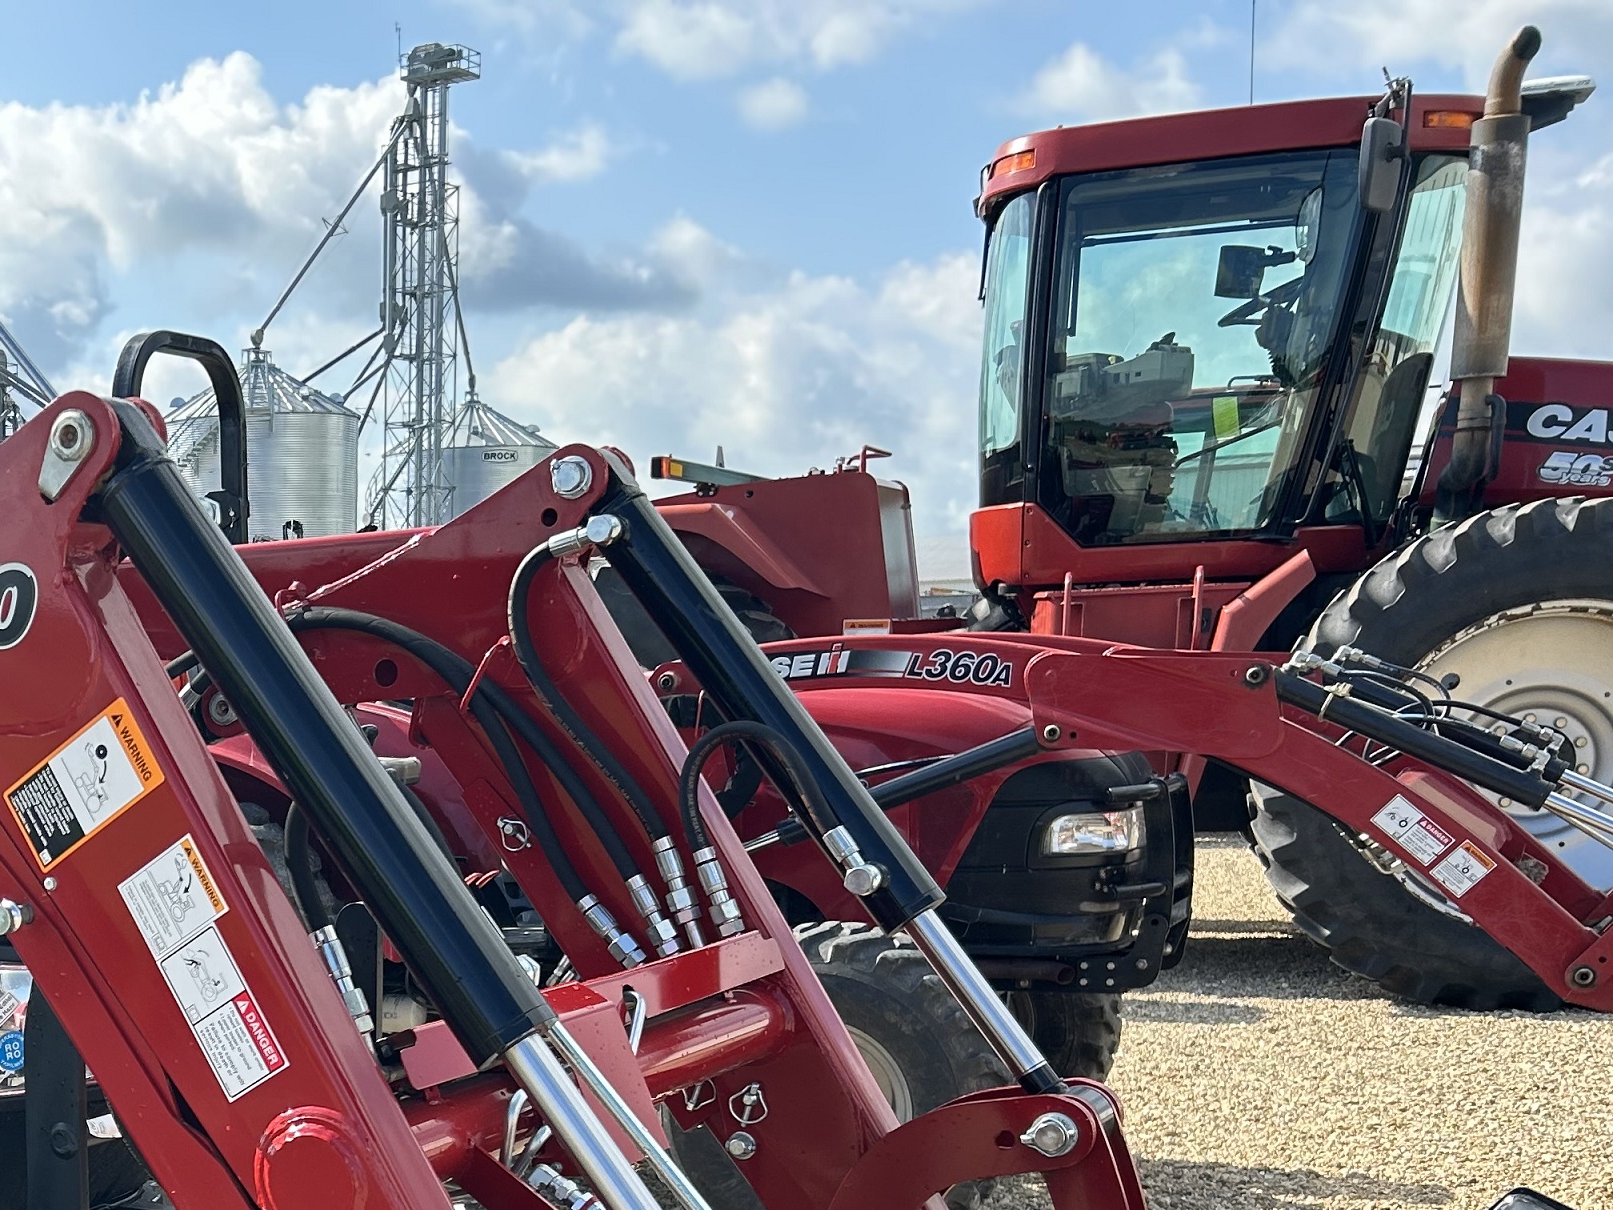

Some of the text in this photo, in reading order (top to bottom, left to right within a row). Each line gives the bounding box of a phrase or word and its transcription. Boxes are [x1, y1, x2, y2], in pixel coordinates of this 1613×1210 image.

[1527, 404, 1613, 442] CA
[484, 452, 516, 460] BROCK
[904, 649, 1014, 687] L360A
[120, 726, 152, 782] WARNING
[1426, 822, 1449, 843] DANGER
[191, 858, 220, 908] WARNING
[4, 1041, 20, 1052] RO
[5, 1049, 21, 1061] RO
[245, 1012, 279, 1066] DANGER
